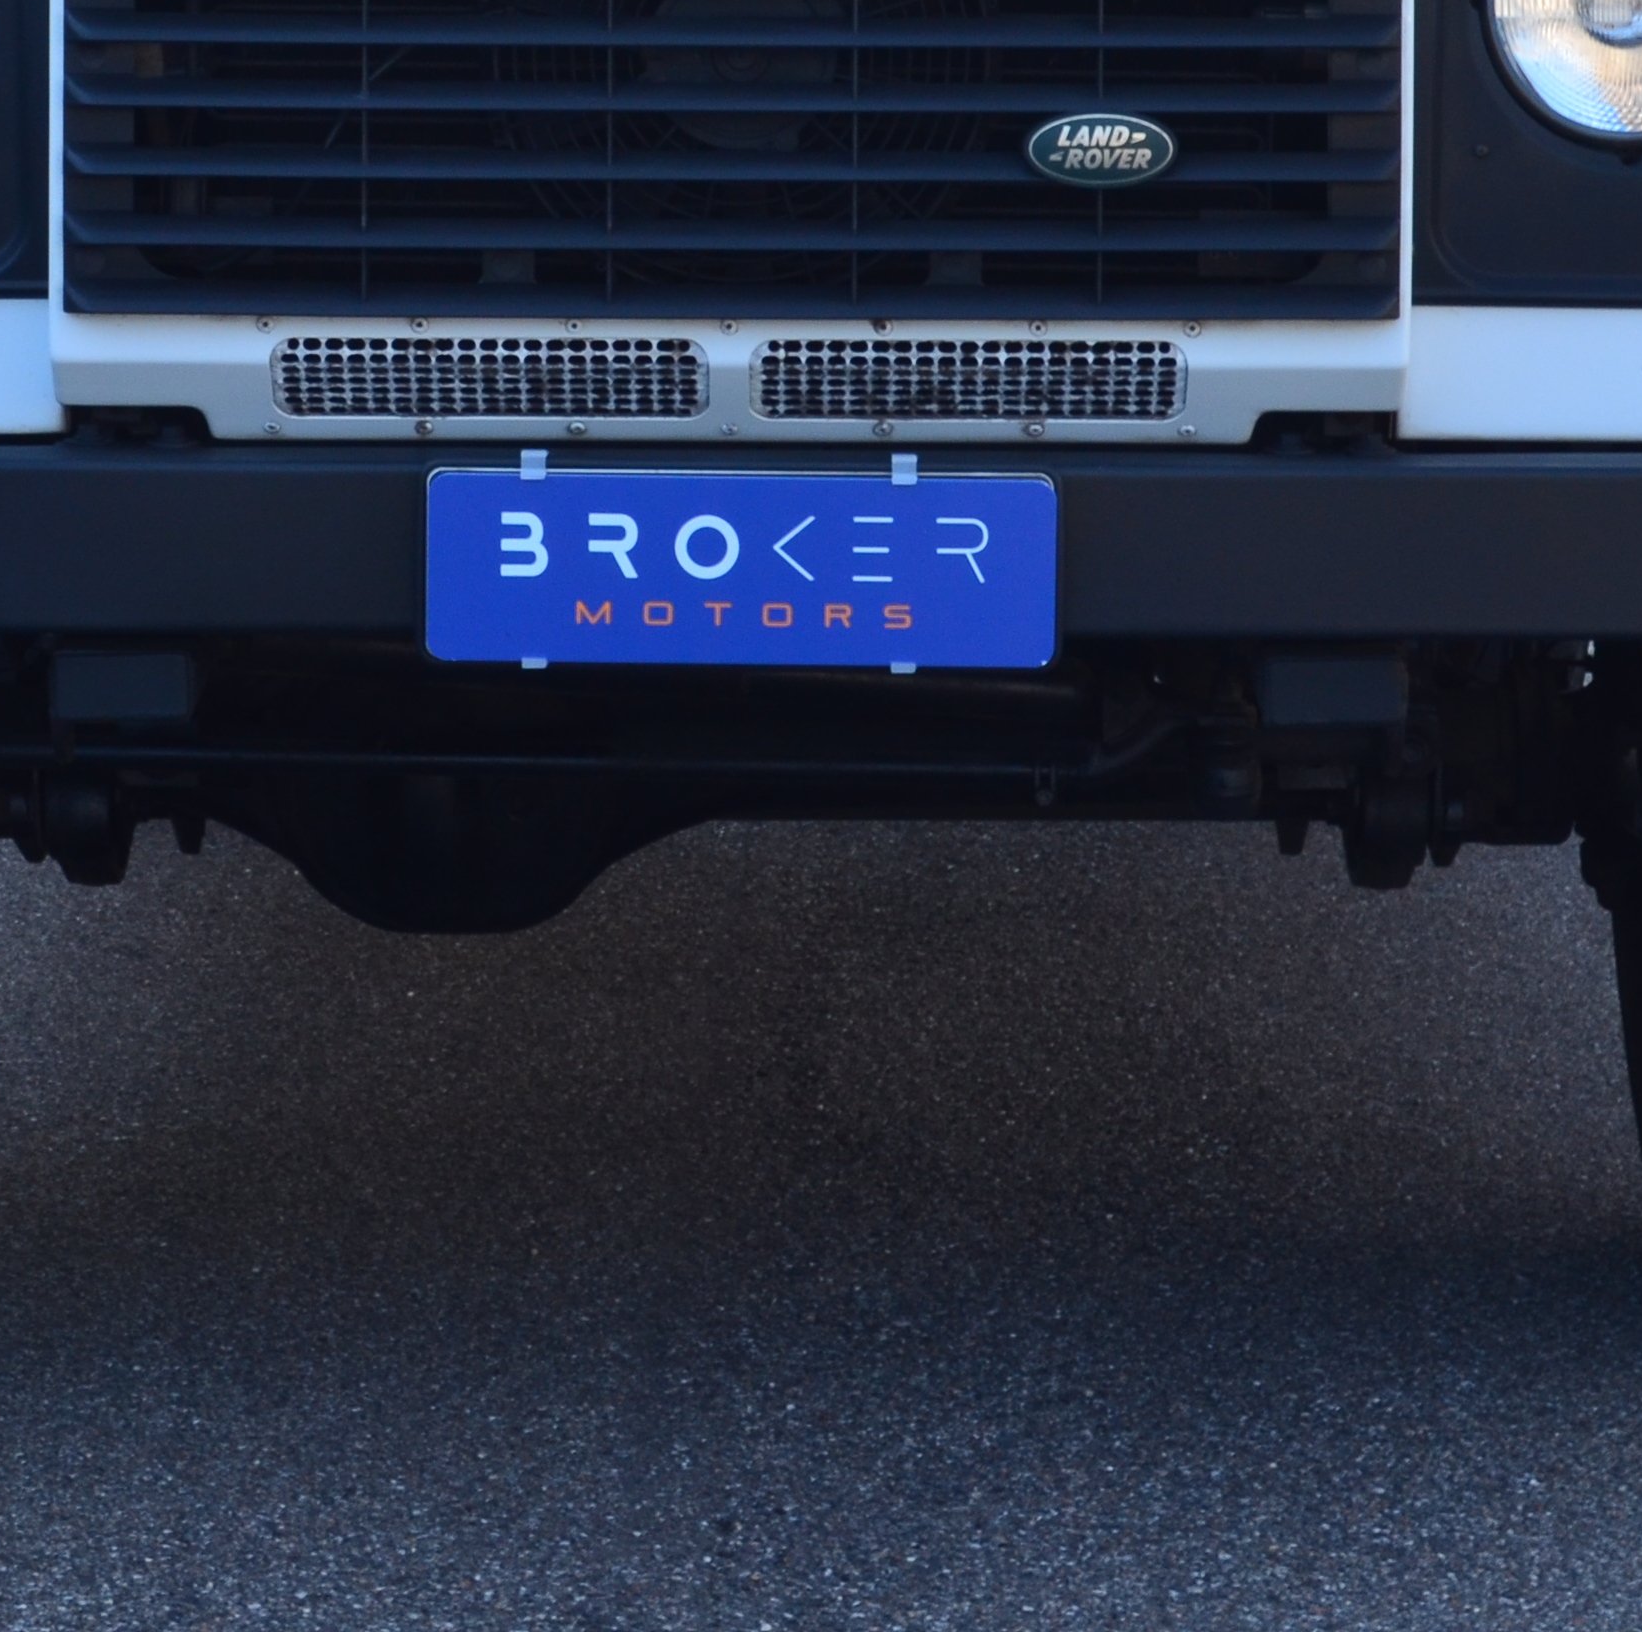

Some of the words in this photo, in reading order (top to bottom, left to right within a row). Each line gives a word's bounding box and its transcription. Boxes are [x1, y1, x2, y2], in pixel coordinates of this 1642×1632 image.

[1057, 125, 1129, 147] LAND
[1064, 148, 1152, 169] ROVER
[499, 511, 990, 584] BROKER
[574, 600, 913, 630] MOTORS
